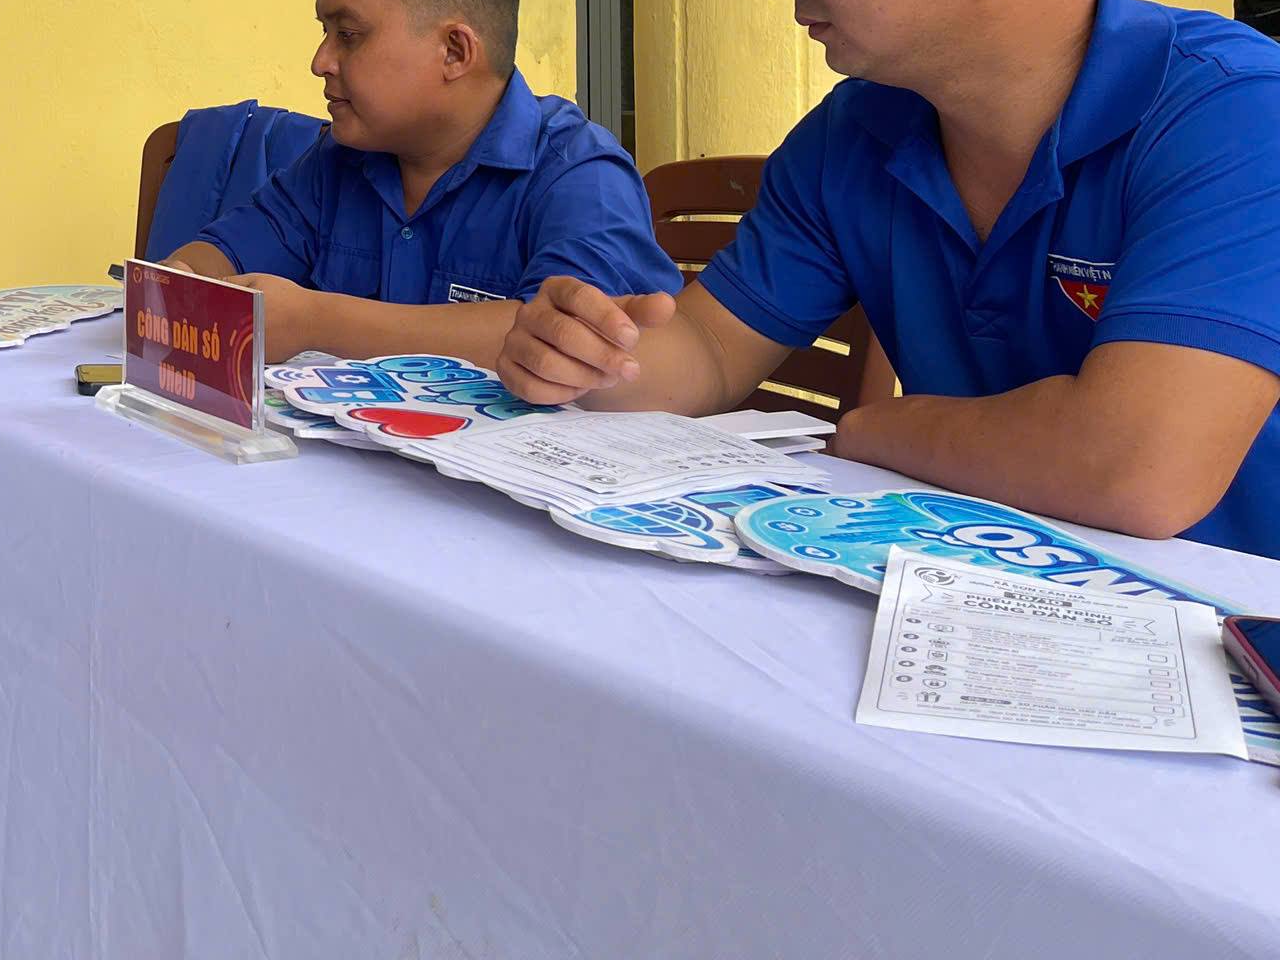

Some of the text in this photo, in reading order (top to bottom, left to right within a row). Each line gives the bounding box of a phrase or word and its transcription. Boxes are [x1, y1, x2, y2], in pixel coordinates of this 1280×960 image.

[137, 309, 220, 362] CÔNG DÂN SỐ
[158, 362, 197, 401] VNeID
[913, 523, 1099, 570] SỐ
[963, 599, 1025, 615] CÔNG
[1032, 609, 1077, 623] DÂN
[1084, 615, 1113, 627] SỐ
